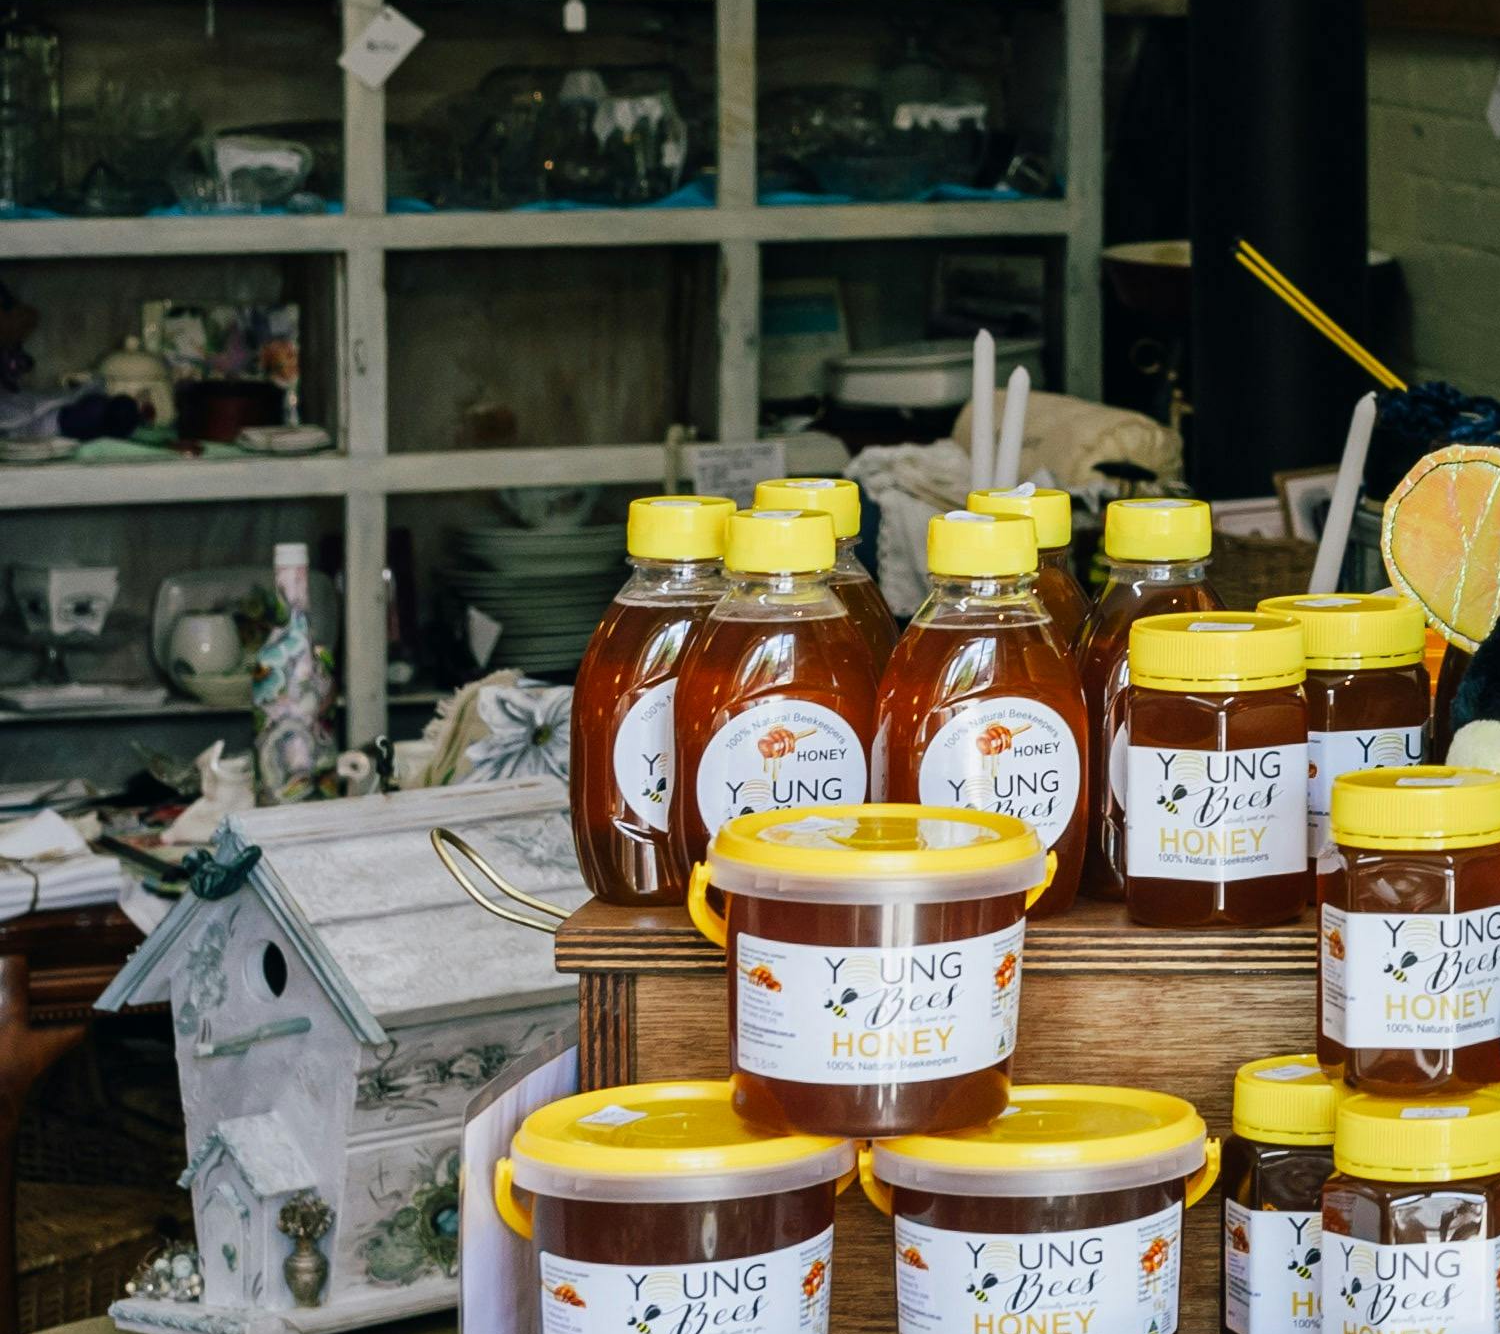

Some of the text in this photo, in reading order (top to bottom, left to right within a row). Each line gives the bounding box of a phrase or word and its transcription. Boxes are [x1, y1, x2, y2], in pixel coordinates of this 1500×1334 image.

[793, 712, 847, 746] Beekeepers
[1009, 708, 1060, 739] Beekeepers
[797, 748, 848, 762] HONEY
[1014, 742, 1061, 758] HONEY
[1194, 783, 1284, 828] Bees
[1160, 827, 1268, 857] HONEY
[1158, 853, 1183, 864] 100%
[1185, 853, 1217, 865] Natural
[864, 982, 965, 1031] Bees
[1384, 987, 1493, 1020] HONEY
[832, 1026, 956, 1058] HONEY
[1385, 1023, 1414, 1033] 100%
[1416, 1024, 1453, 1034] Natural
[826, 1060, 855, 1071] 100%
[1005, 1268, 1107, 1315] Bees
[1366, 1281, 1466, 1326] Bees
